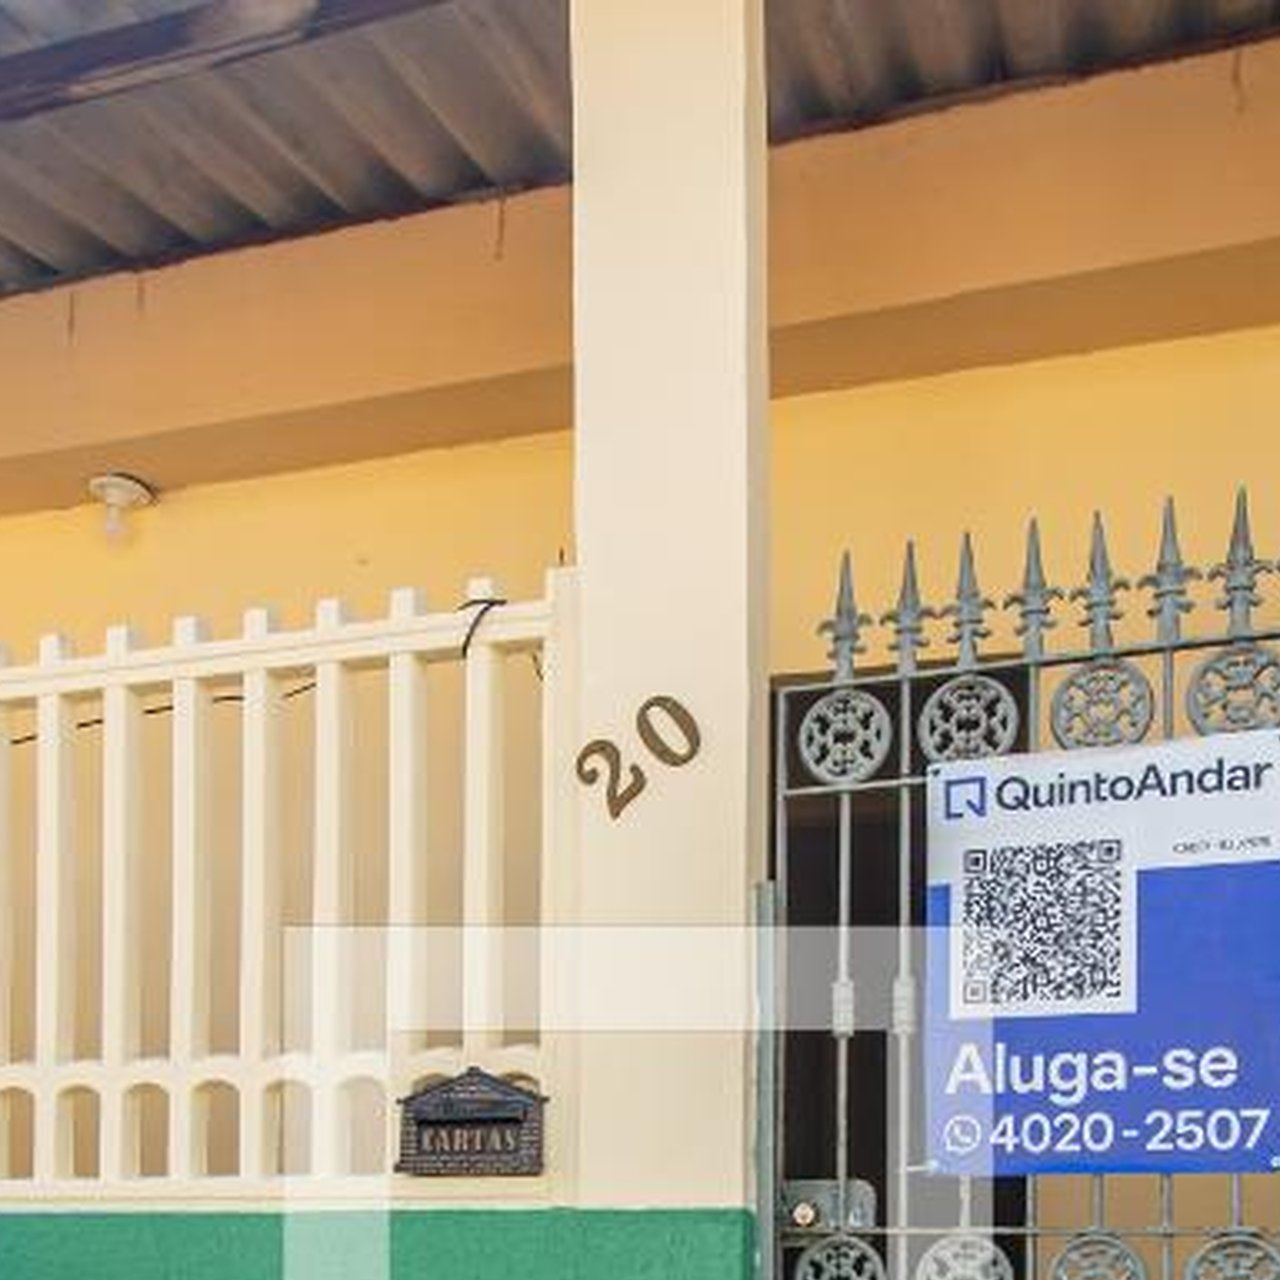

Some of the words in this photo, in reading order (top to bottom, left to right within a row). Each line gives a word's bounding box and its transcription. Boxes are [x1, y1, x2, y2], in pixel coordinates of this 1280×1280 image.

[576, 695, 701, 820] 20
[995, 760, 1273, 812] QuintoAndar
[945, 1043, 1239, 1106] Aluga-se
[421, 1128, 517, 1152] CARTAS
